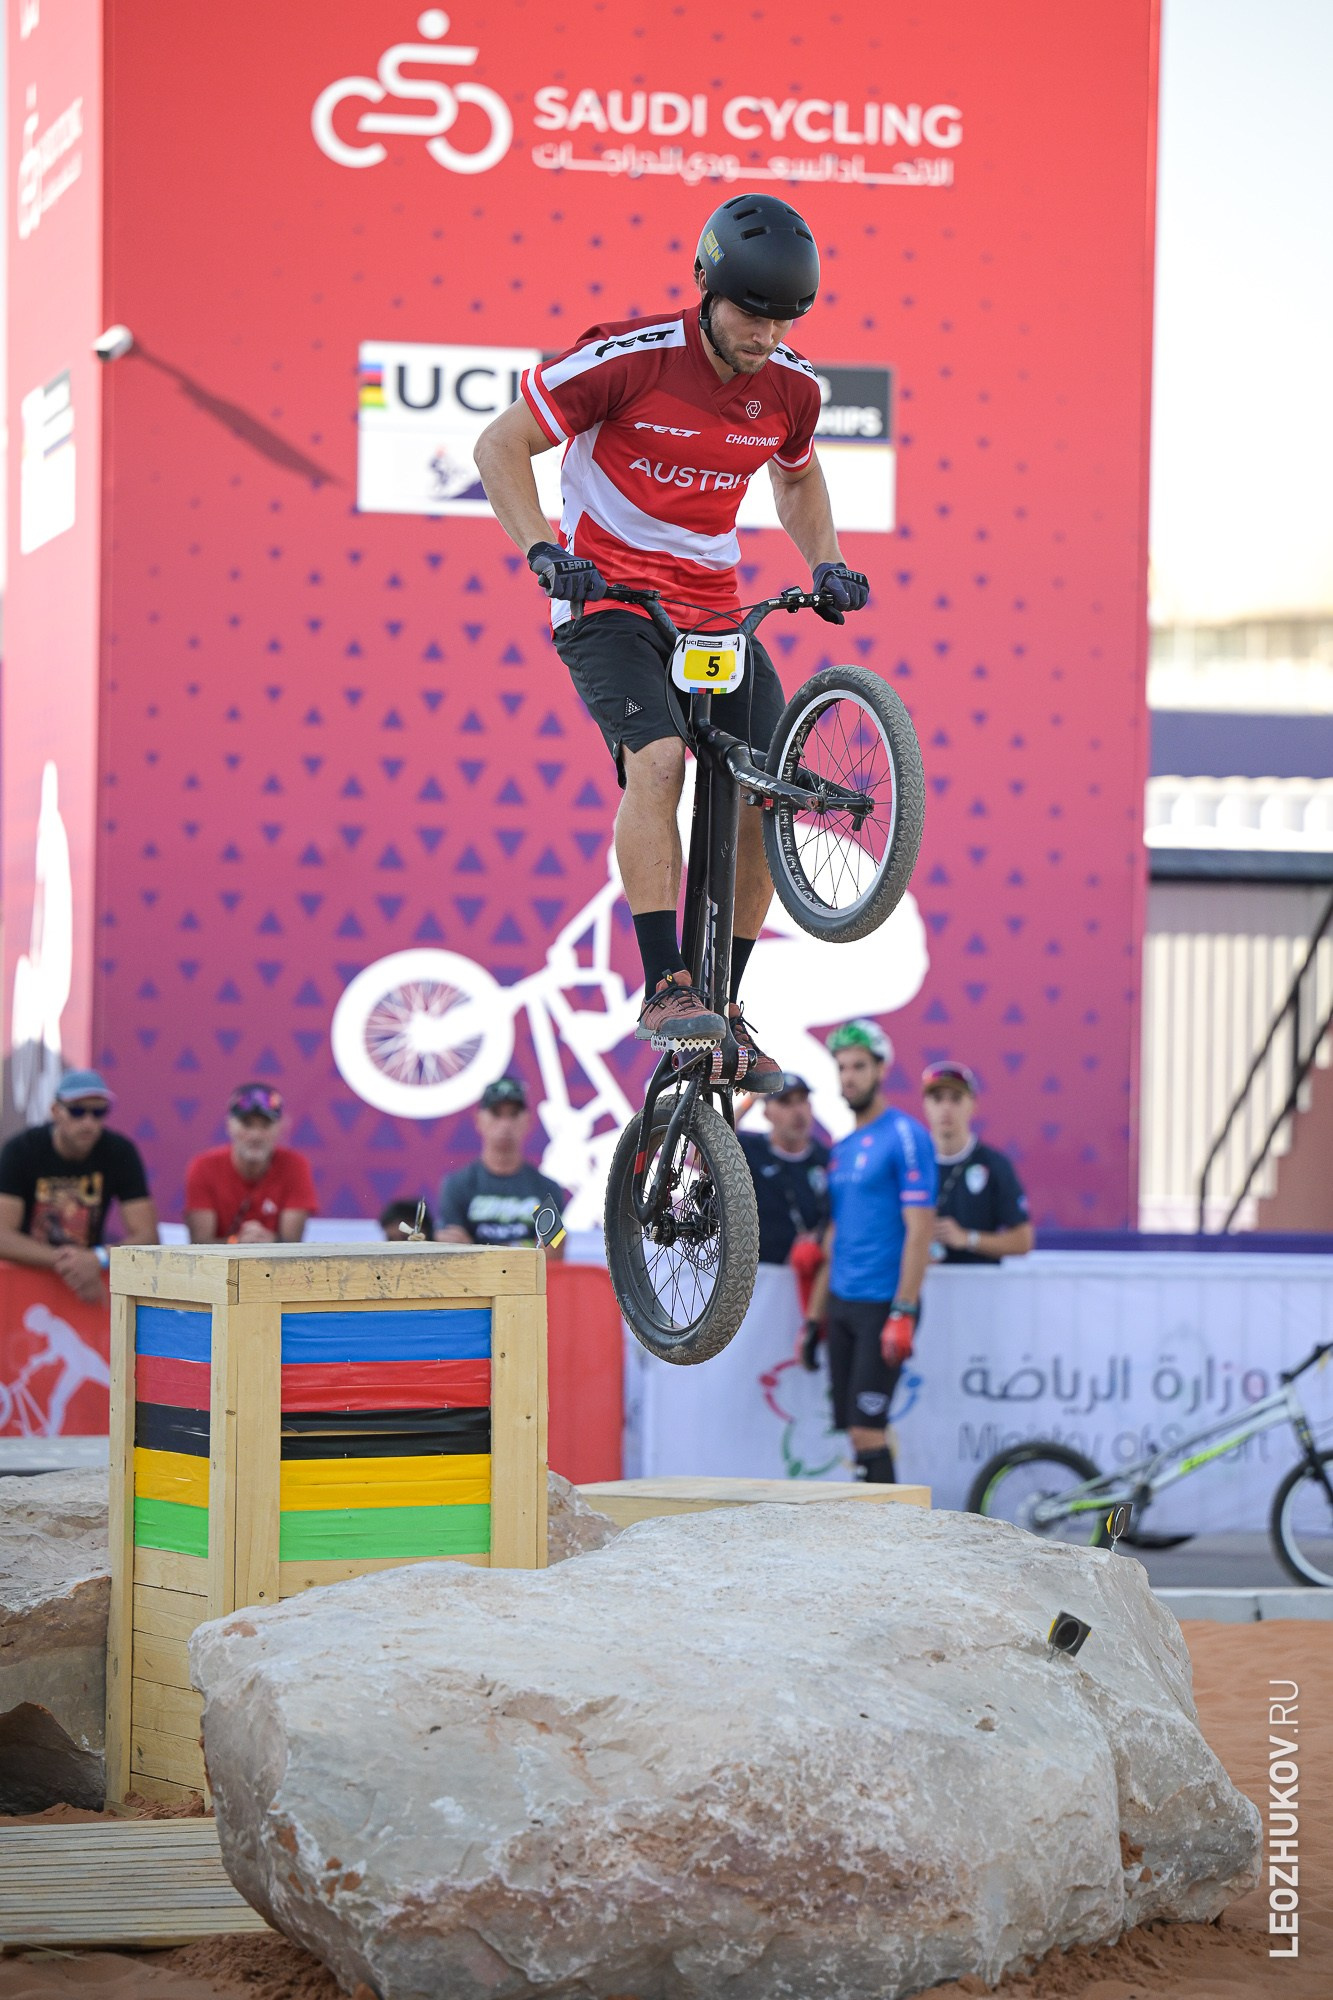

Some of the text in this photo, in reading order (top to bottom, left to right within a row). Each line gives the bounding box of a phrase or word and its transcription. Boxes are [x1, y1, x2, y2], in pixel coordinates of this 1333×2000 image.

[532, 86, 964, 149] SAUDI CYCLING
[594, 328, 676, 358] FELT
[395, 364, 519, 413] UCI
[633, 421, 702, 438] FELT
[725, 433, 780, 447] CHAOYANG
[705, 655, 721, 678] 5
[961, 1353, 1269, 1416] وزارة الرياضة
